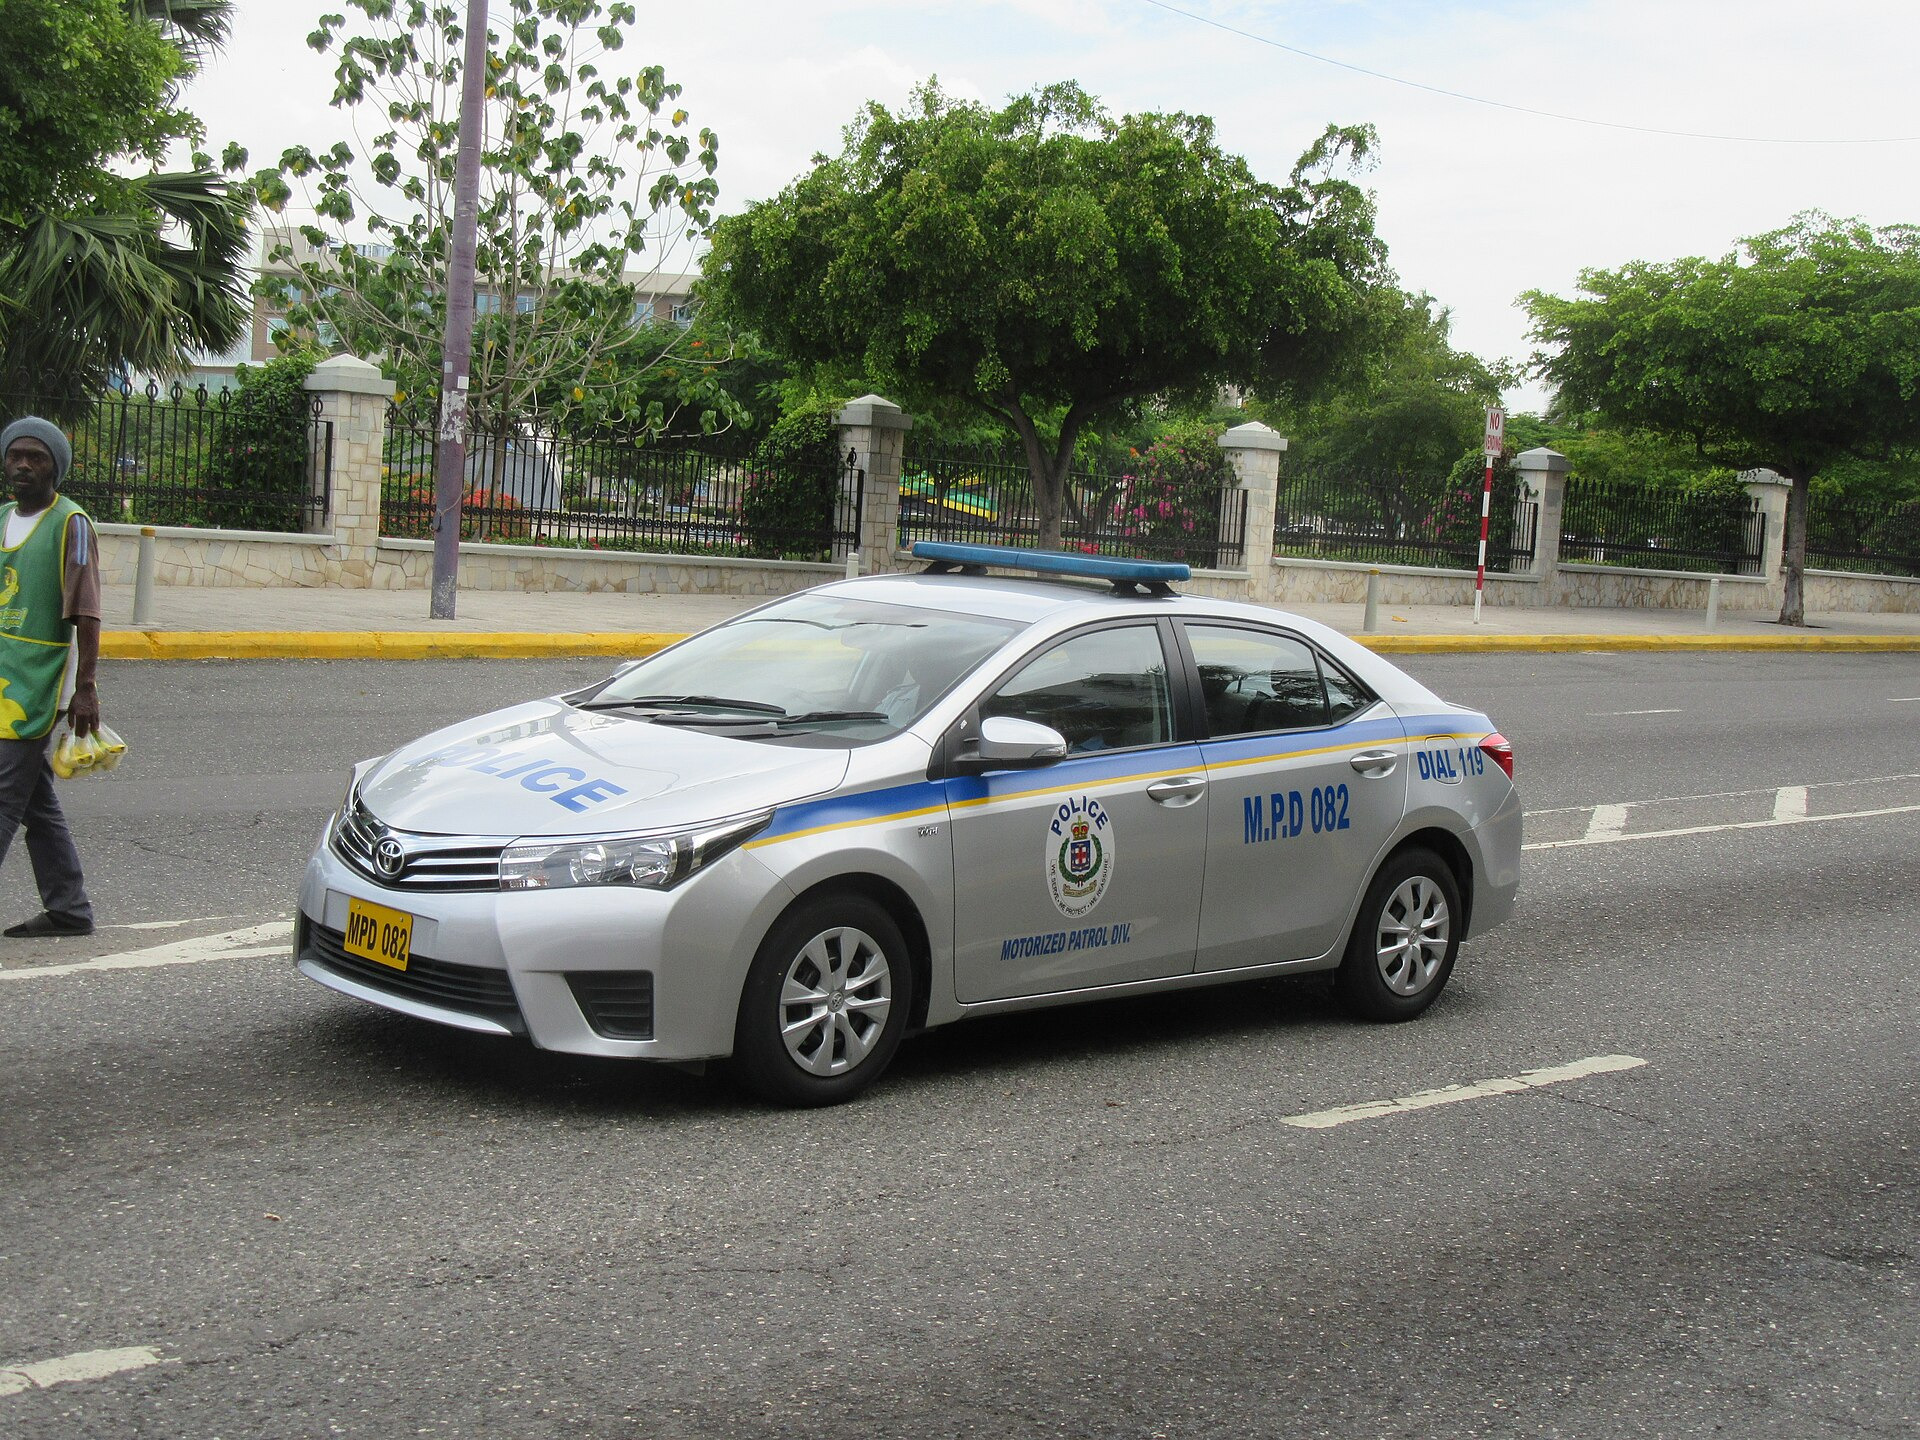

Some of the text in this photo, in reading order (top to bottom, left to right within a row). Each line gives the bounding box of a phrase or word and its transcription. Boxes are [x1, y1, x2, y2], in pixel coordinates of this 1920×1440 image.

[1490, 412, 1500, 430] NO
[403, 745, 629, 814] POLICE
[1417, 746, 1484, 780] DIAL 119
[1050, 795, 1109, 837] POLICE
[1243, 783, 1350, 845] M.P.D 082
[1065, 904, 1088, 916] PROTECT
[347, 911, 408, 962] MPD 082
[1000, 922, 1131, 961] MOTORIZED PATROL DIV.
